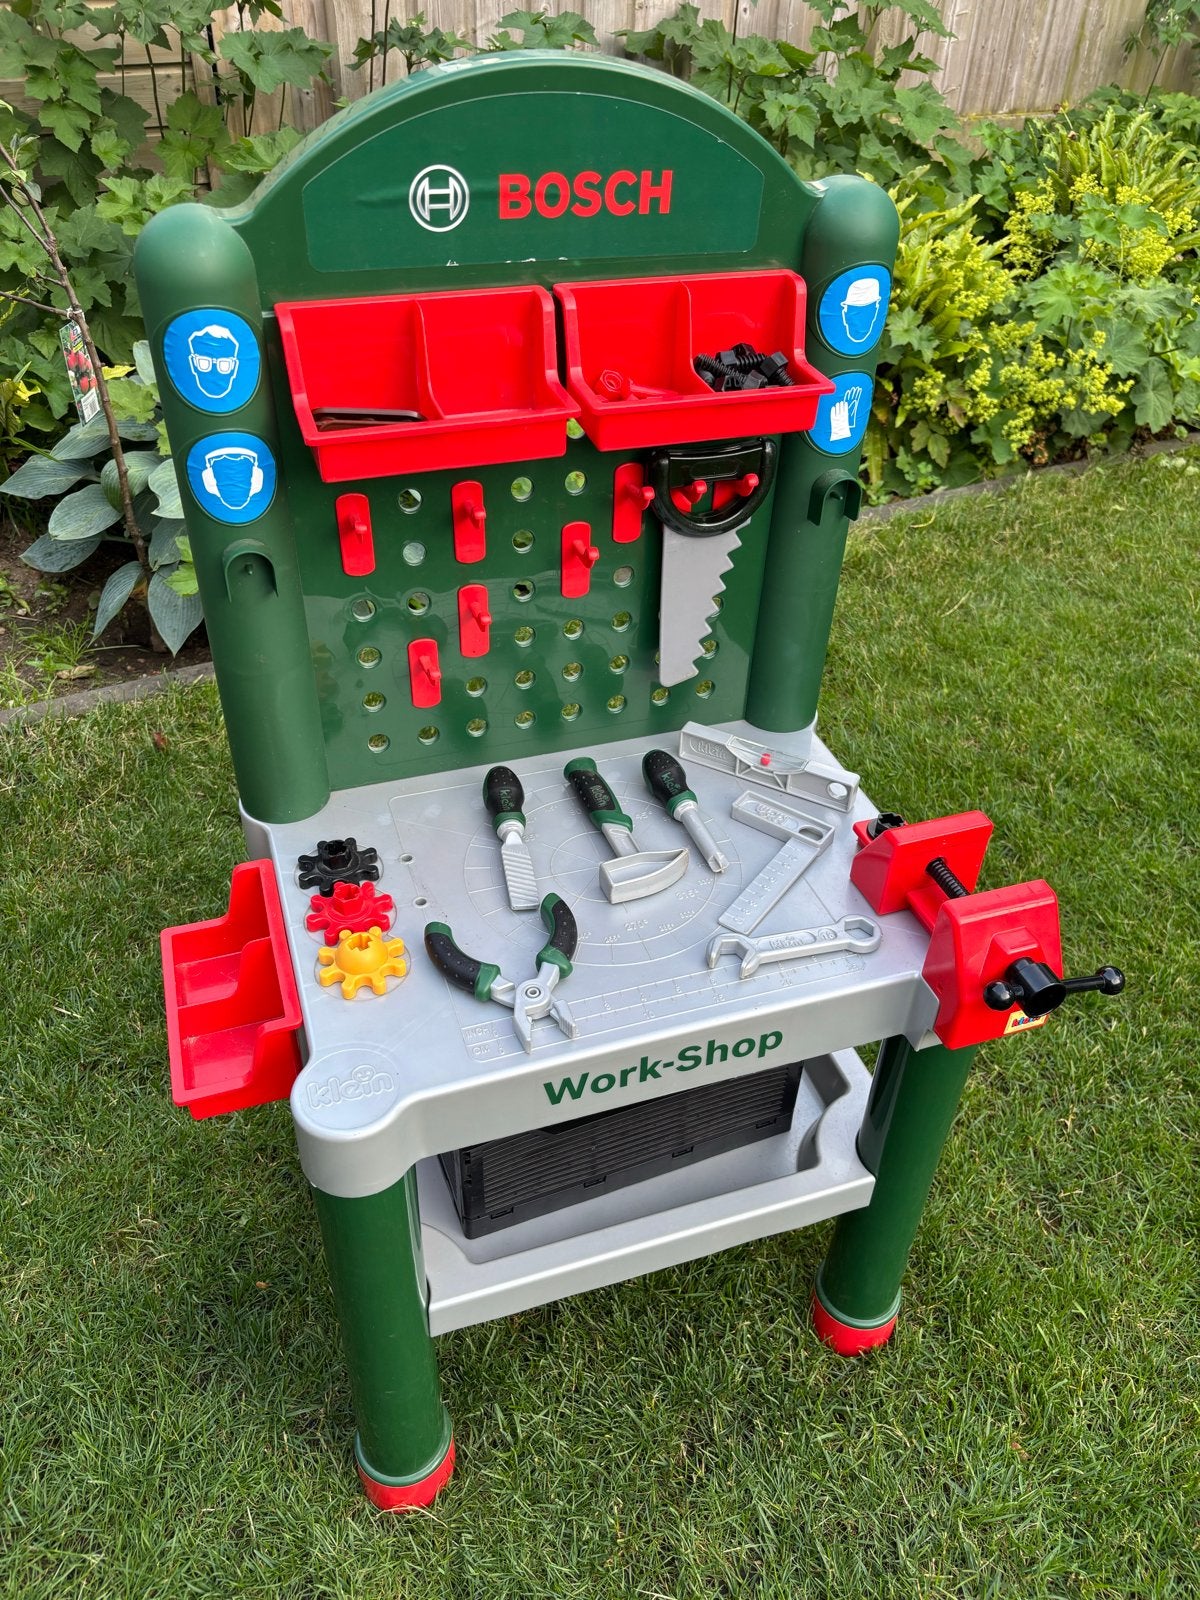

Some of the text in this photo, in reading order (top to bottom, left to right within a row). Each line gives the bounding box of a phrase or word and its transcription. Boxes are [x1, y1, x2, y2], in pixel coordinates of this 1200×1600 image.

[498, 169, 673, 220] BOSCH
[661, 770, 681, 796] klein
[306, 1064, 395, 1110] klein
[543, 1030, 783, 1106] Work-Shop
